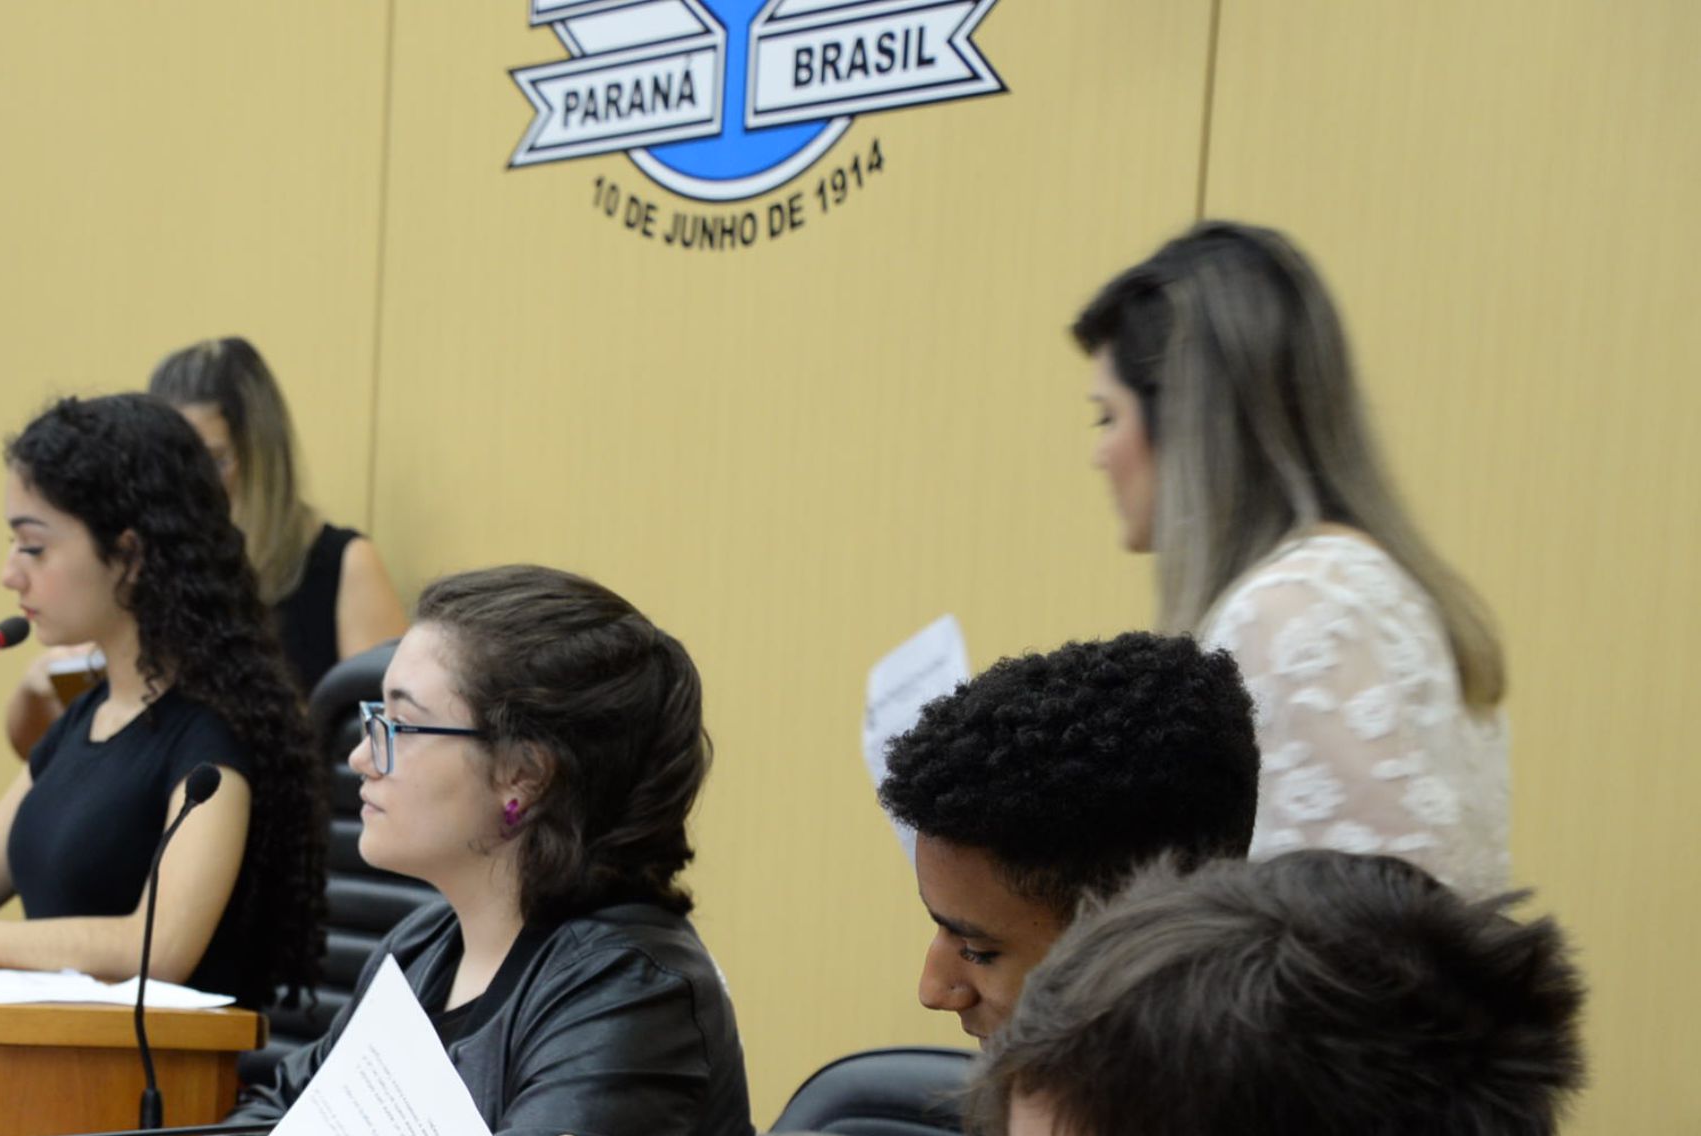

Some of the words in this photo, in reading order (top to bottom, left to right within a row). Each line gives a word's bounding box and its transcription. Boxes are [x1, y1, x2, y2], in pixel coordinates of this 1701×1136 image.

[561, 54, 697, 129] PARANÁ
[793, 25, 936, 89] BRASIL
[593, 176, 620, 217] 10
[625, 195, 657, 239] DE
[664, 211, 758, 250] JUNHO
[768, 192, 805, 241] DE
[815, 138, 884, 213] 1914
